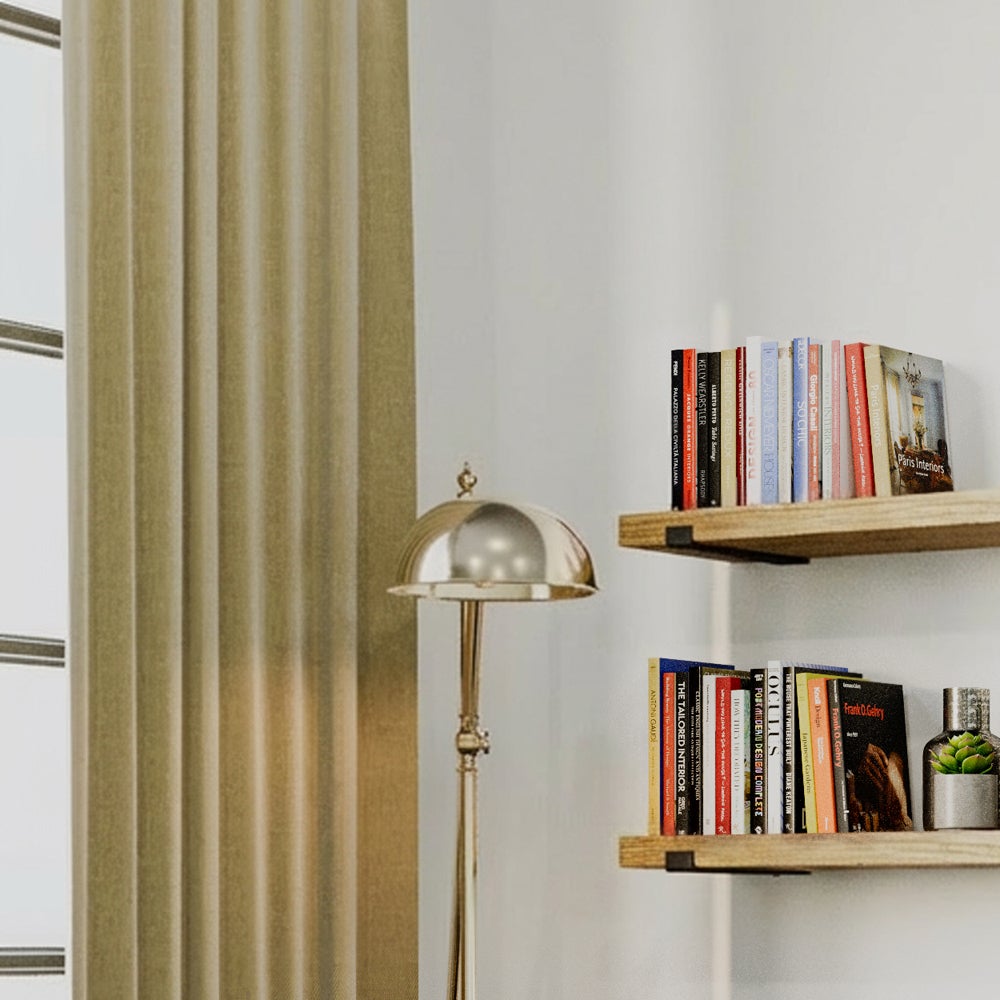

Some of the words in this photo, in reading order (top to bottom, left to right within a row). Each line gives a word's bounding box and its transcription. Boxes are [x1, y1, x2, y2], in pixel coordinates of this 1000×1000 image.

[724, 360, 733, 413] REGENCY
[809, 374, 818, 404] Giorgio
[870, 384, 880, 407] Paris
[797, 419, 807, 447] CHIC
[809, 406, 818, 431] Casali
[872, 409, 882, 448] Interiors
[724, 419, 733, 458] REDUX
[898, 453, 916, 468] Paris
[916, 457, 945, 474] Interiors
[677, 681, 686, 700] THE
[677, 701, 686, 748] TAILORED
[755, 688, 763, 741] POSTMODERN
[768, 675, 780, 756] OCULUS
[814, 705, 822, 728] Design
[832, 708, 840, 730] Frank
[844, 702, 860, 716] Frank
[866, 703, 884, 720] Gehry
[755, 743, 763, 773] DESIGN
[834, 741, 842, 767] Gehry
[677, 748, 686, 792] INTERIOR
[755, 775, 763, 816] COMPLETE
